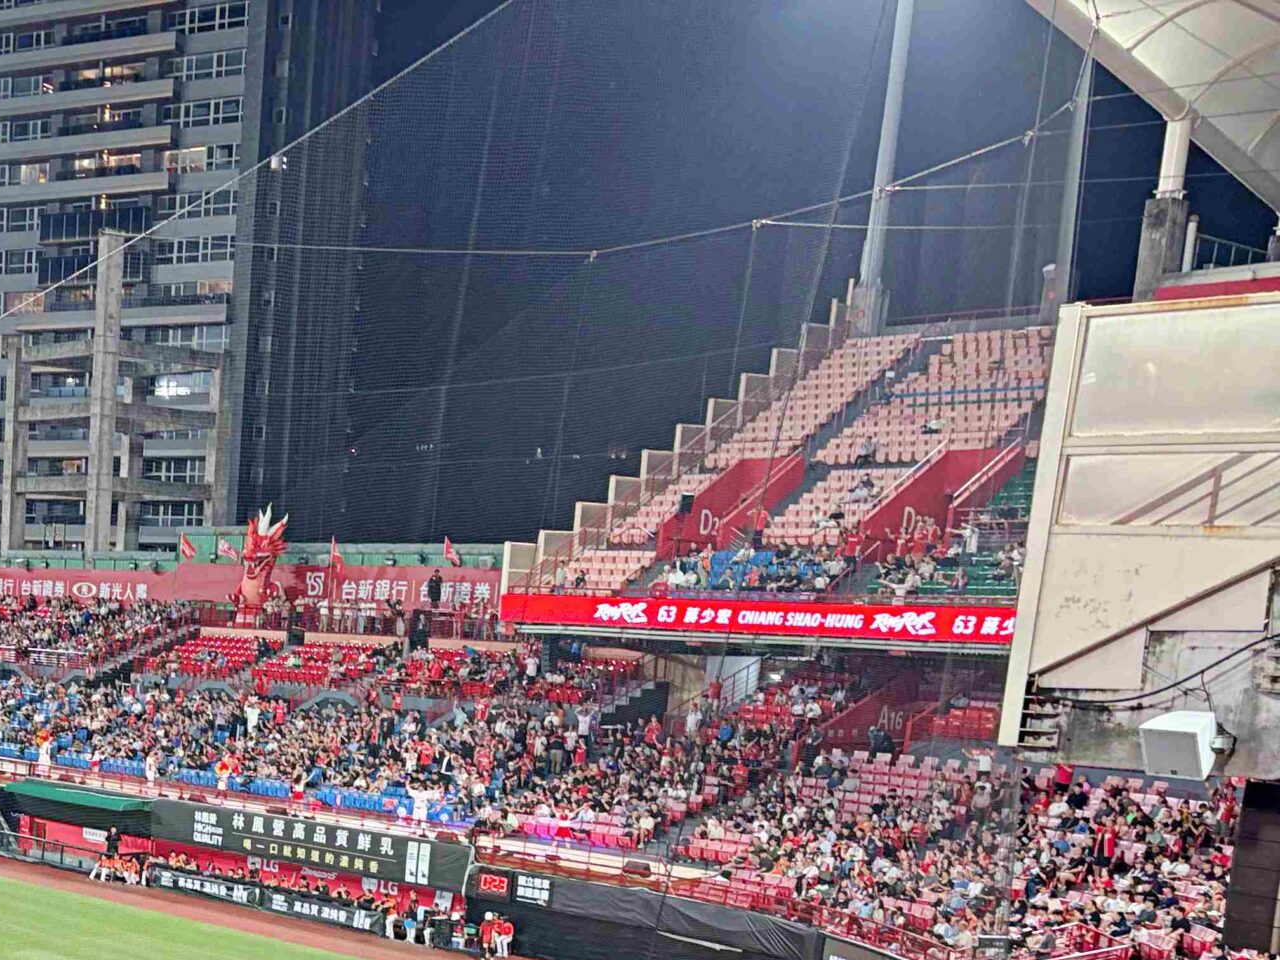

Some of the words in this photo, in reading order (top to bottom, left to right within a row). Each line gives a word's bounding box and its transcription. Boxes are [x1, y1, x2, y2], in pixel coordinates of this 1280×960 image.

[21, 580, 64, 598] 台新證券
[99, 582, 148, 600] 新光人壽
[341, 580, 409, 600] 台新銀行
[656, 605, 677, 623] 63
[738, 610, 784, 626] CHIANG
[785, 612, 864, 629] SHAO-HUNG
[951, 615, 977, 635] 63
[877, 705, 904, 731] A16
[193, 832, 223, 846] QUALITY
[232, 813, 394, 856] 林鳳營高品質鮮乳
[263, 859, 280, 873] LG
[380, 881, 398, 895] LG
